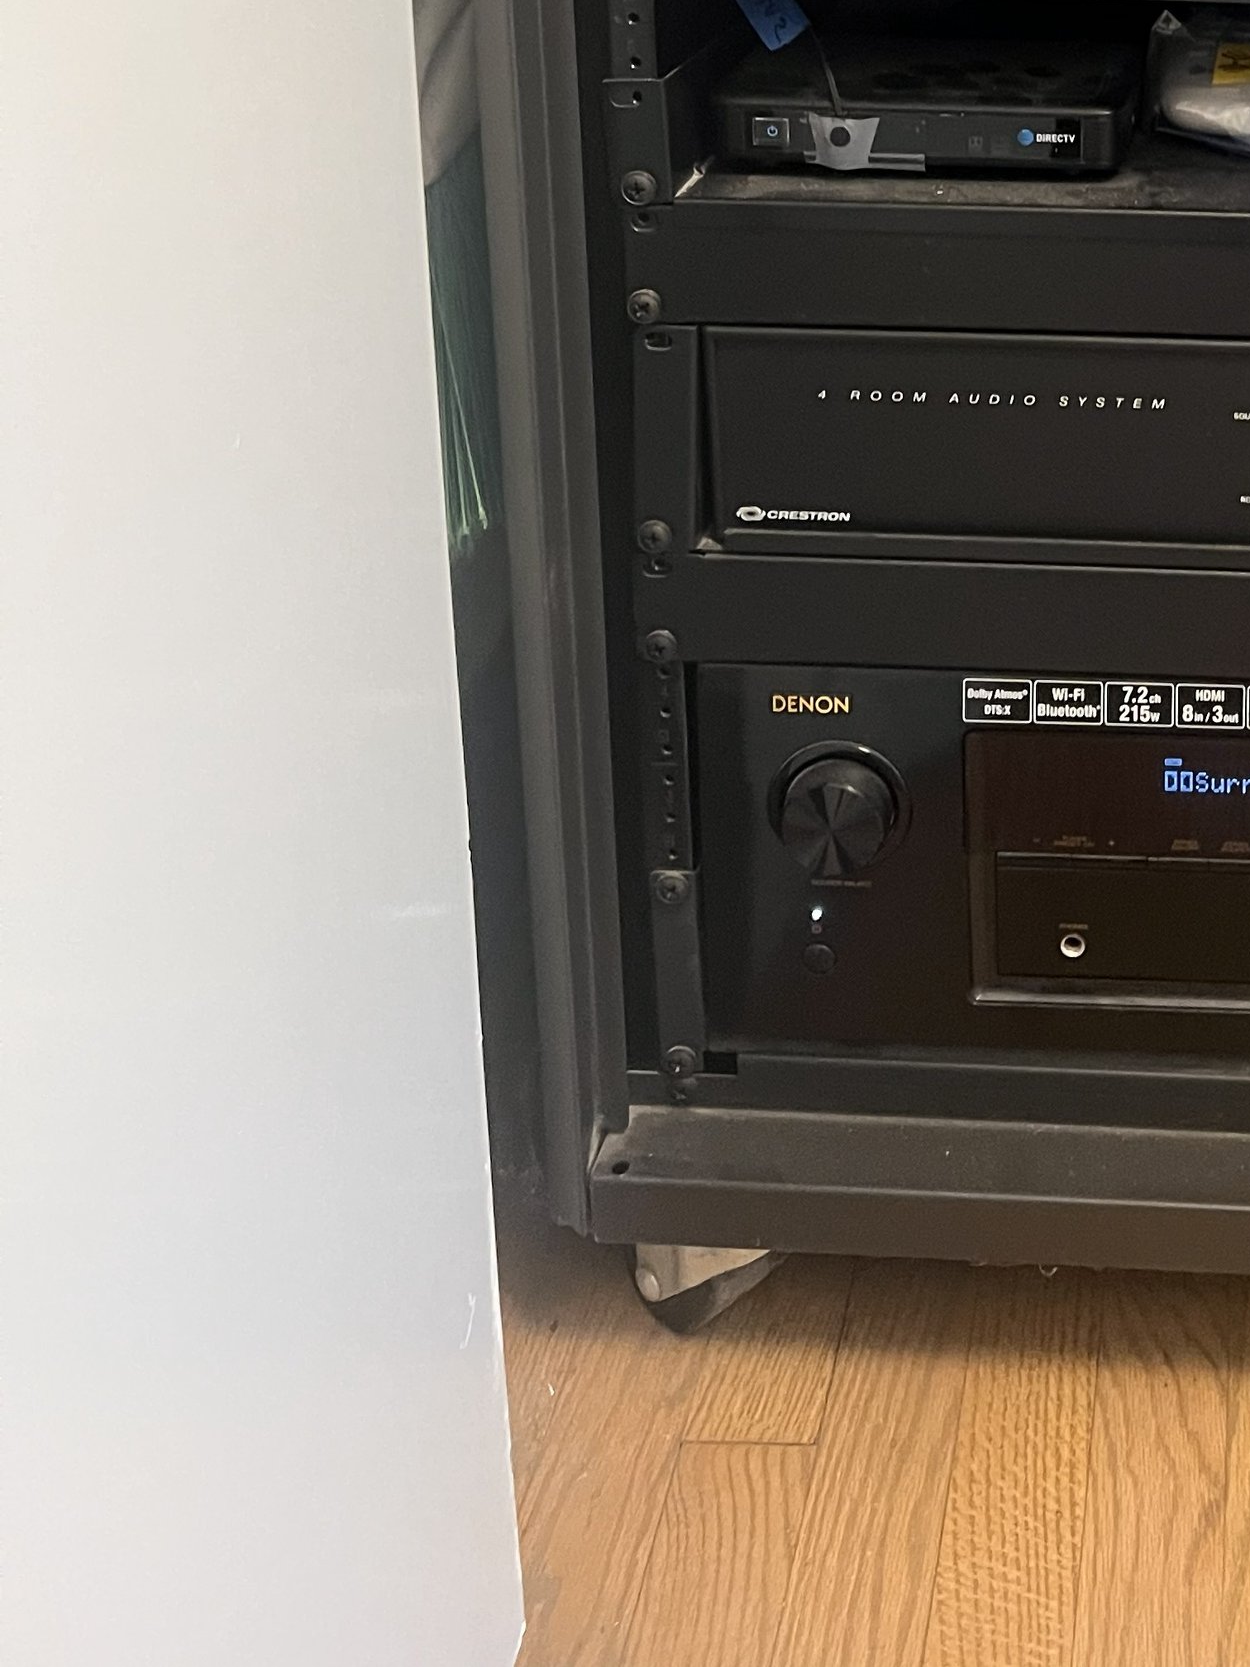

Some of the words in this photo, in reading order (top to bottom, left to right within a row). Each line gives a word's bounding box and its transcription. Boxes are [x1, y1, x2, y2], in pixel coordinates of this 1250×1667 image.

[1036, 133, 1076, 143] DIRECTV
[818, 390, 826, 399] 4
[850, 390, 927, 403] ROOM
[949, 393, 1036, 406] AUDIO
[1058, 395, 1166, 410] SYSTEM
[767, 510, 850, 522] CRESTRON
[1052, 688, 1085, 702] Wi-Fi
[1195, 689, 1225, 702] HDMI
[772, 694, 849, 714] DENON
